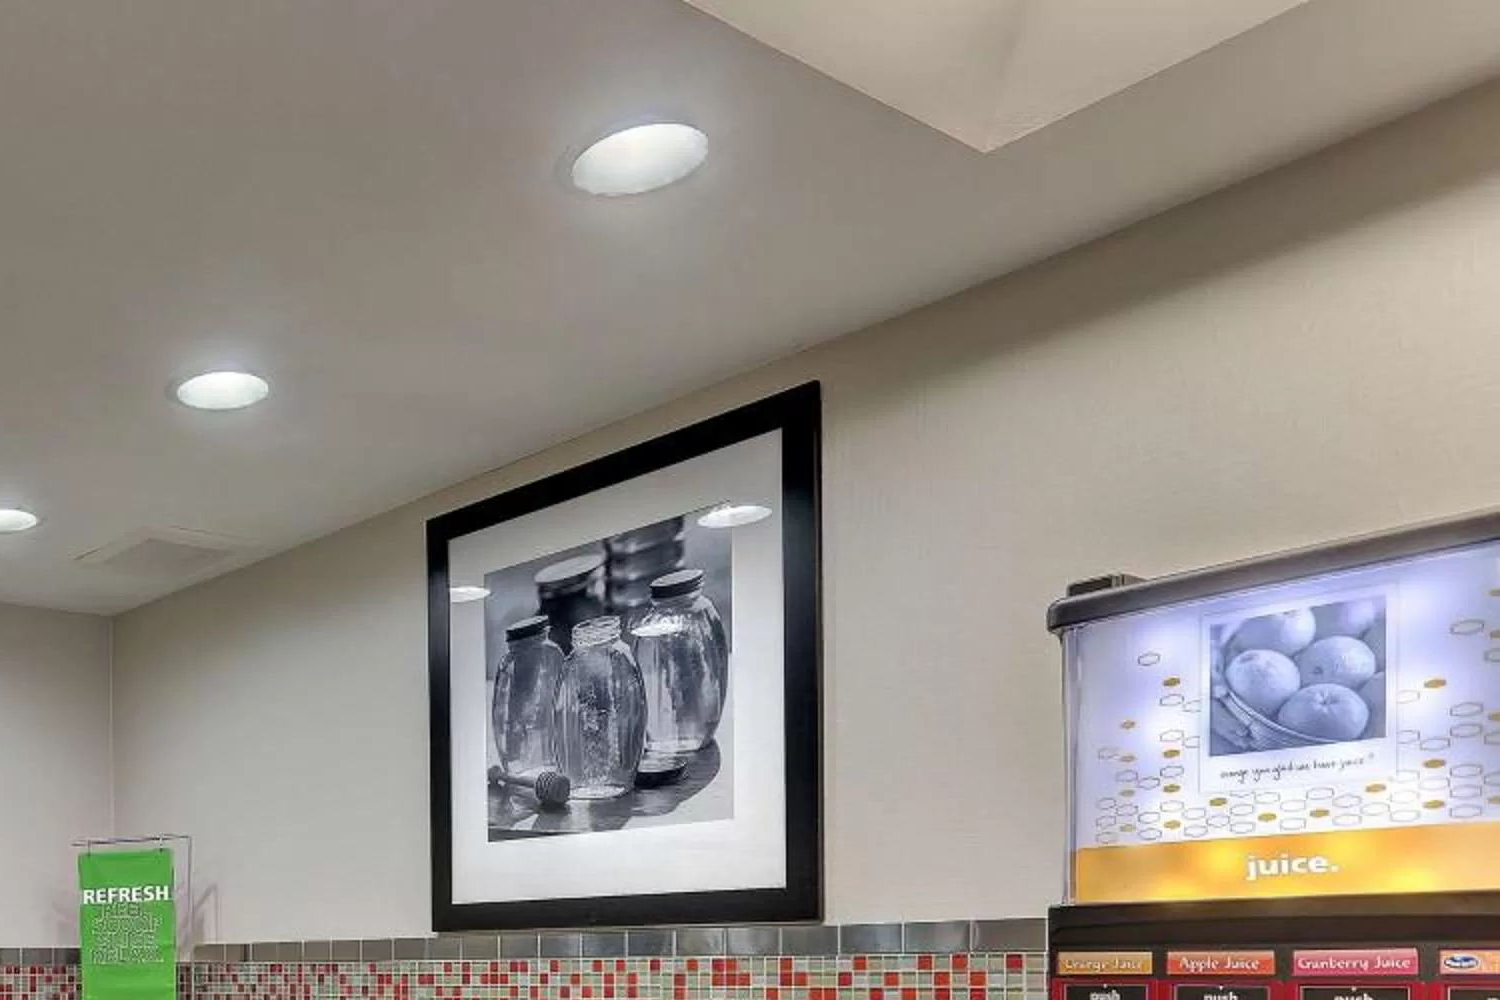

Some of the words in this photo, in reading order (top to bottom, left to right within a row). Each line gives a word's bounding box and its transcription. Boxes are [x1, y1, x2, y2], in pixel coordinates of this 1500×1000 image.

[1245, 853, 1340, 881] juice.
[83, 885, 169, 904] REFRESH
[1179, 957, 1220, 974] Apple
[1224, 957, 1260, 971] Juice
[1298, 955, 1369, 970] Cranberry
[1374, 955, 1411, 968] Juice
